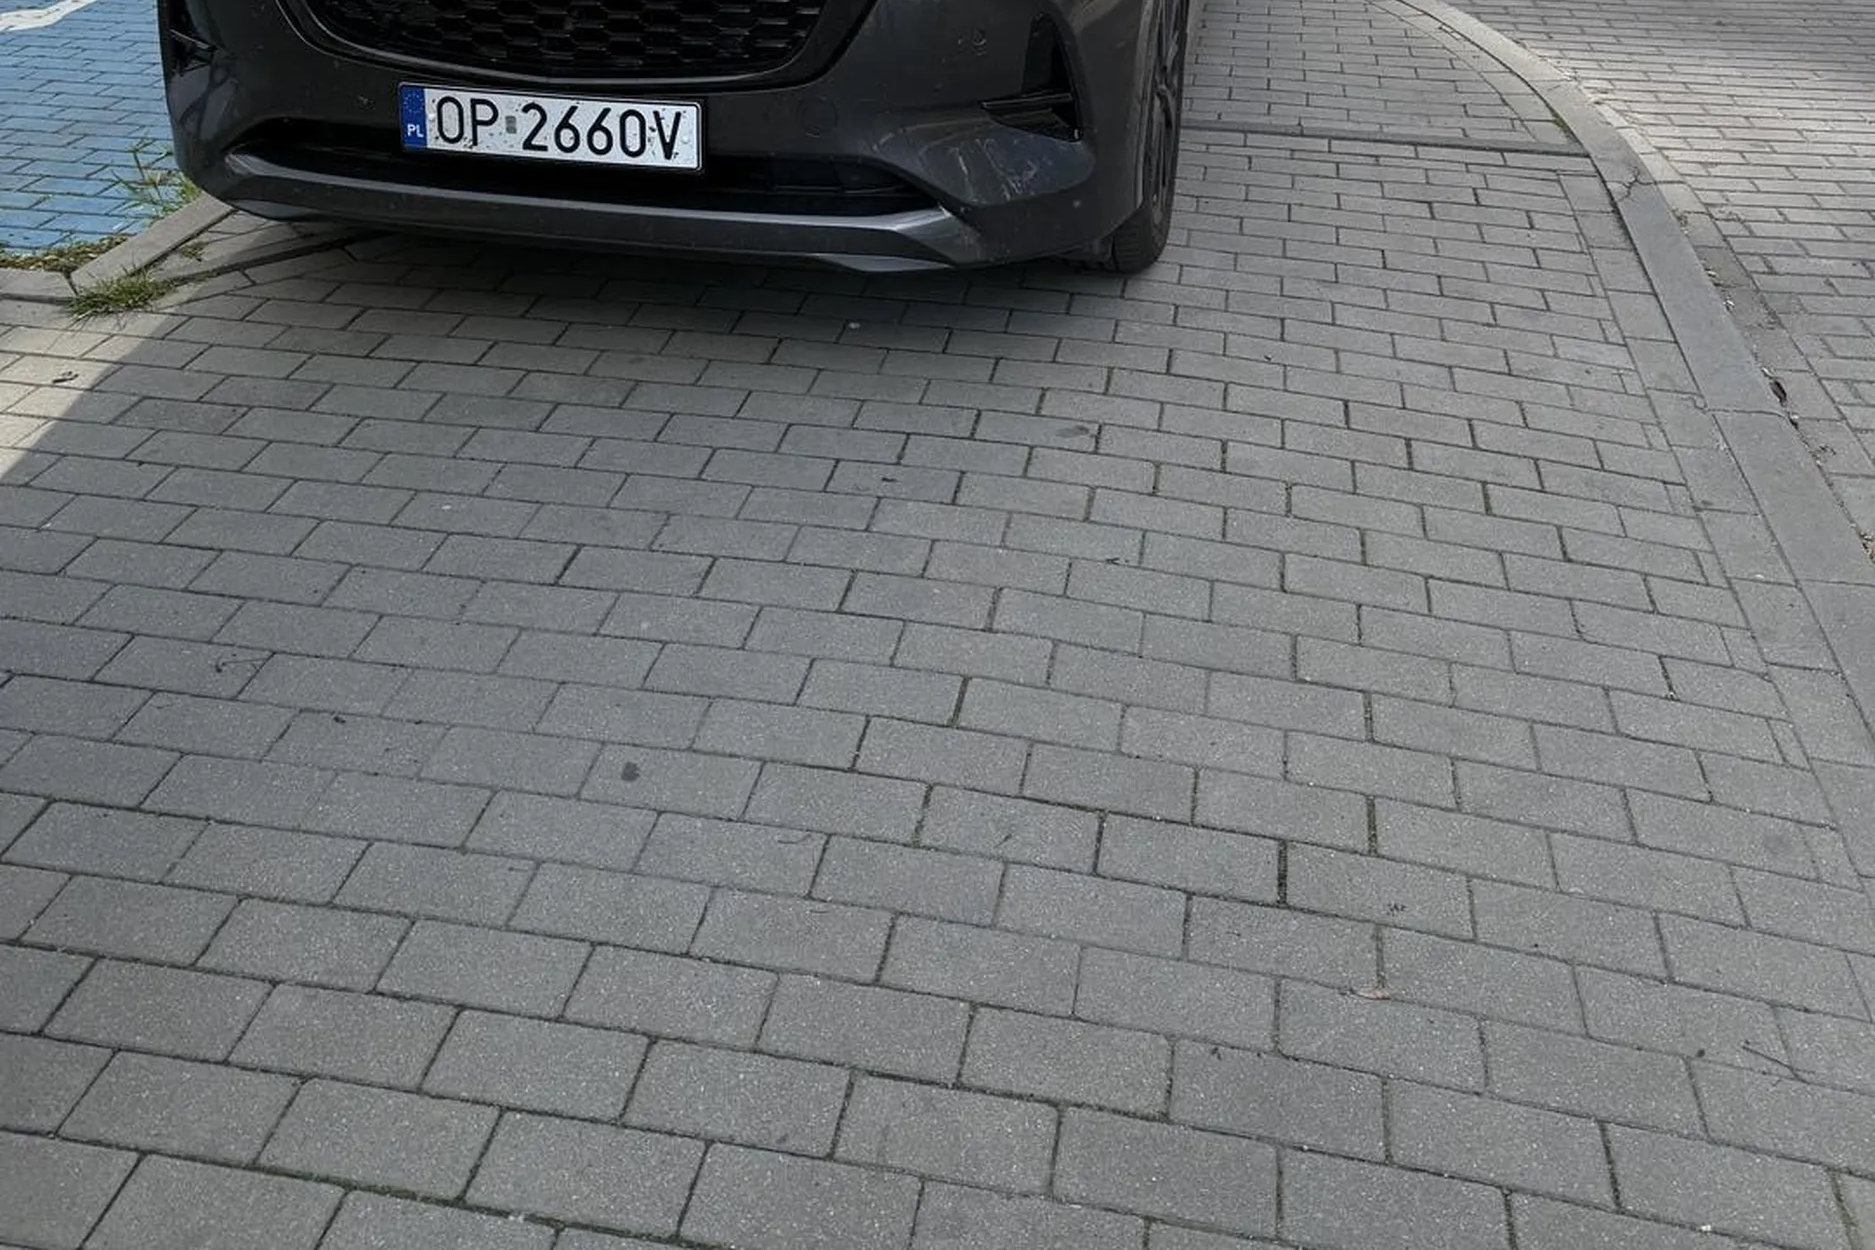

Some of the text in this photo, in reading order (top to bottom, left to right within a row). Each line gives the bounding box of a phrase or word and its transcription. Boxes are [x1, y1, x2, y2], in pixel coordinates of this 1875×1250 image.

[407, 123, 424, 138] PL
[436, 96, 683, 161] OP 2660V
